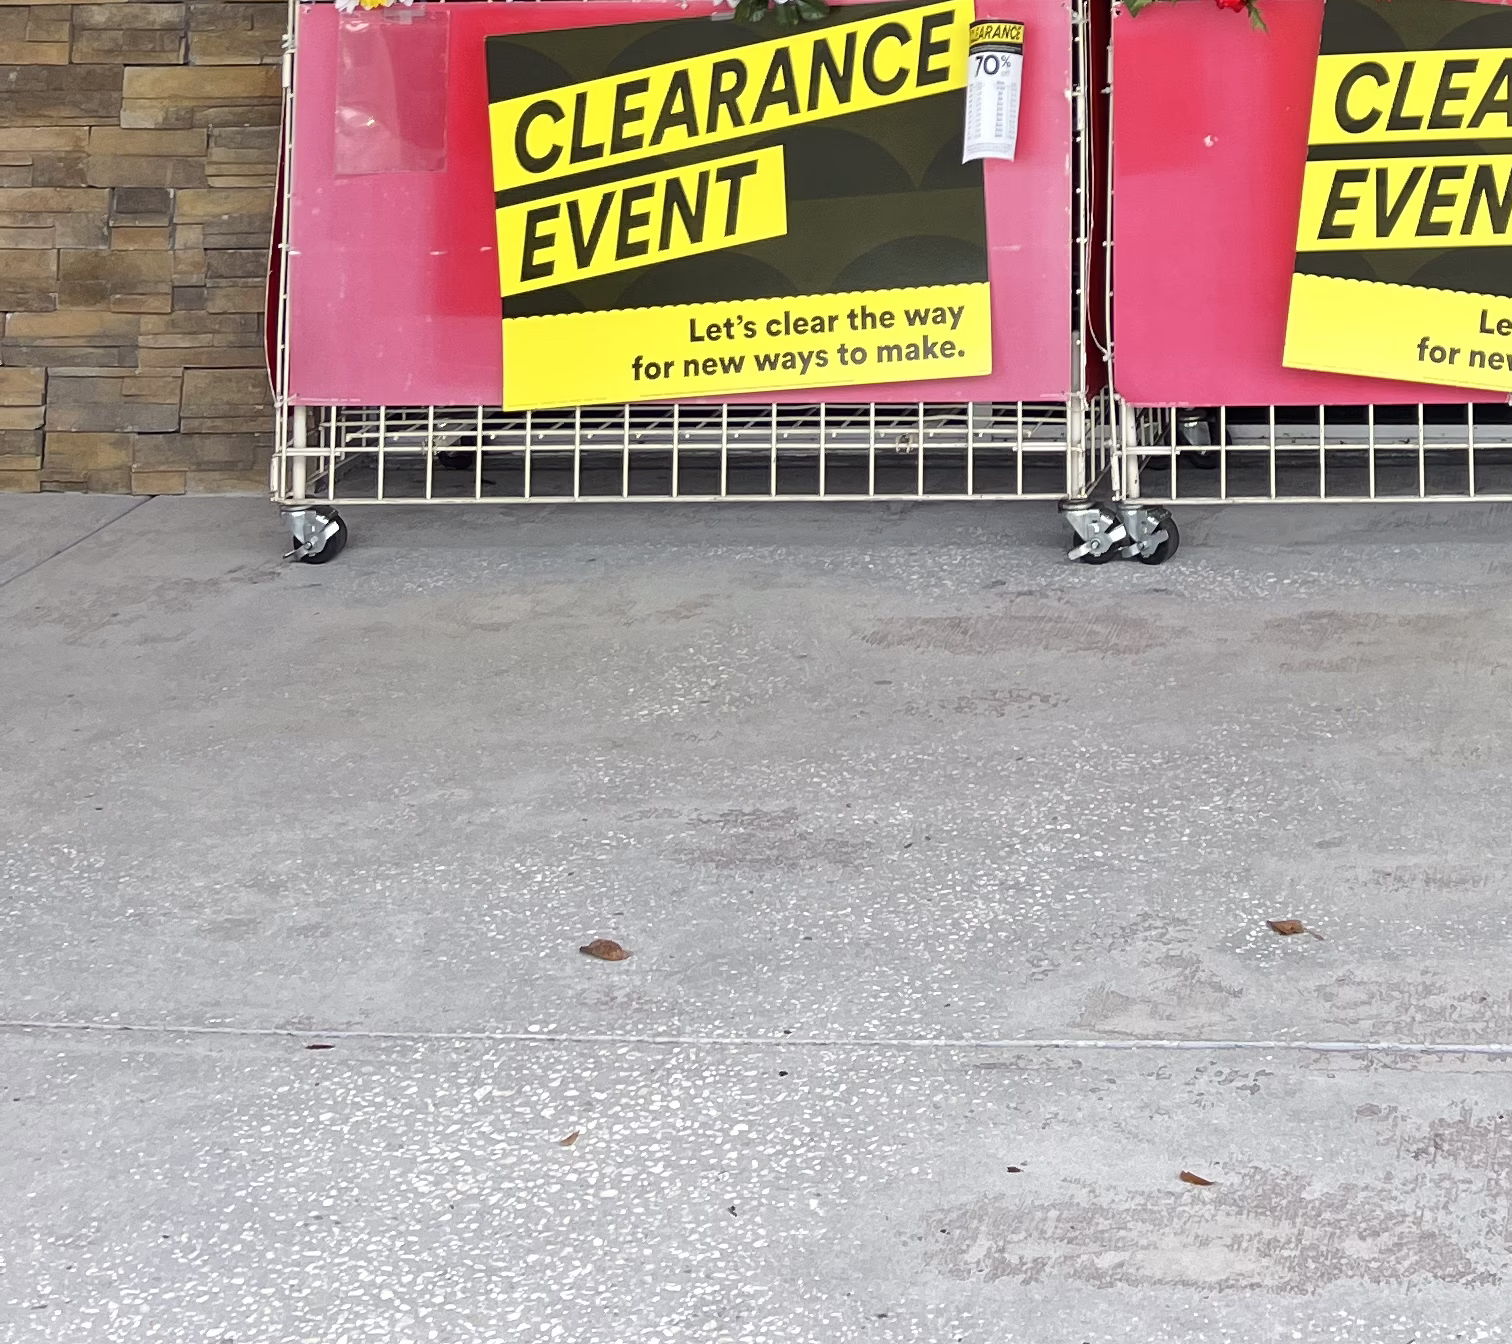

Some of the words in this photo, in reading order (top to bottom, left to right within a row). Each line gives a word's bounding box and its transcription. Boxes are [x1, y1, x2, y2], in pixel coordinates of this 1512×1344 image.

[513, 8, 957, 175] CLEARANCE
[518, 158, 760, 284] EVENT
[689, 315, 757, 343] Let's
[765, 310, 839, 338] clear
[846, 305, 895, 331] the
[903, 305, 965, 331] way
[631, 355, 675, 381] for
[683, 355, 746, 378] new
[753, 349, 829, 376] ways
[836, 343, 868, 366] to
[877, 334, 966, 363] make.
[1416, 336, 1461, 365] for
